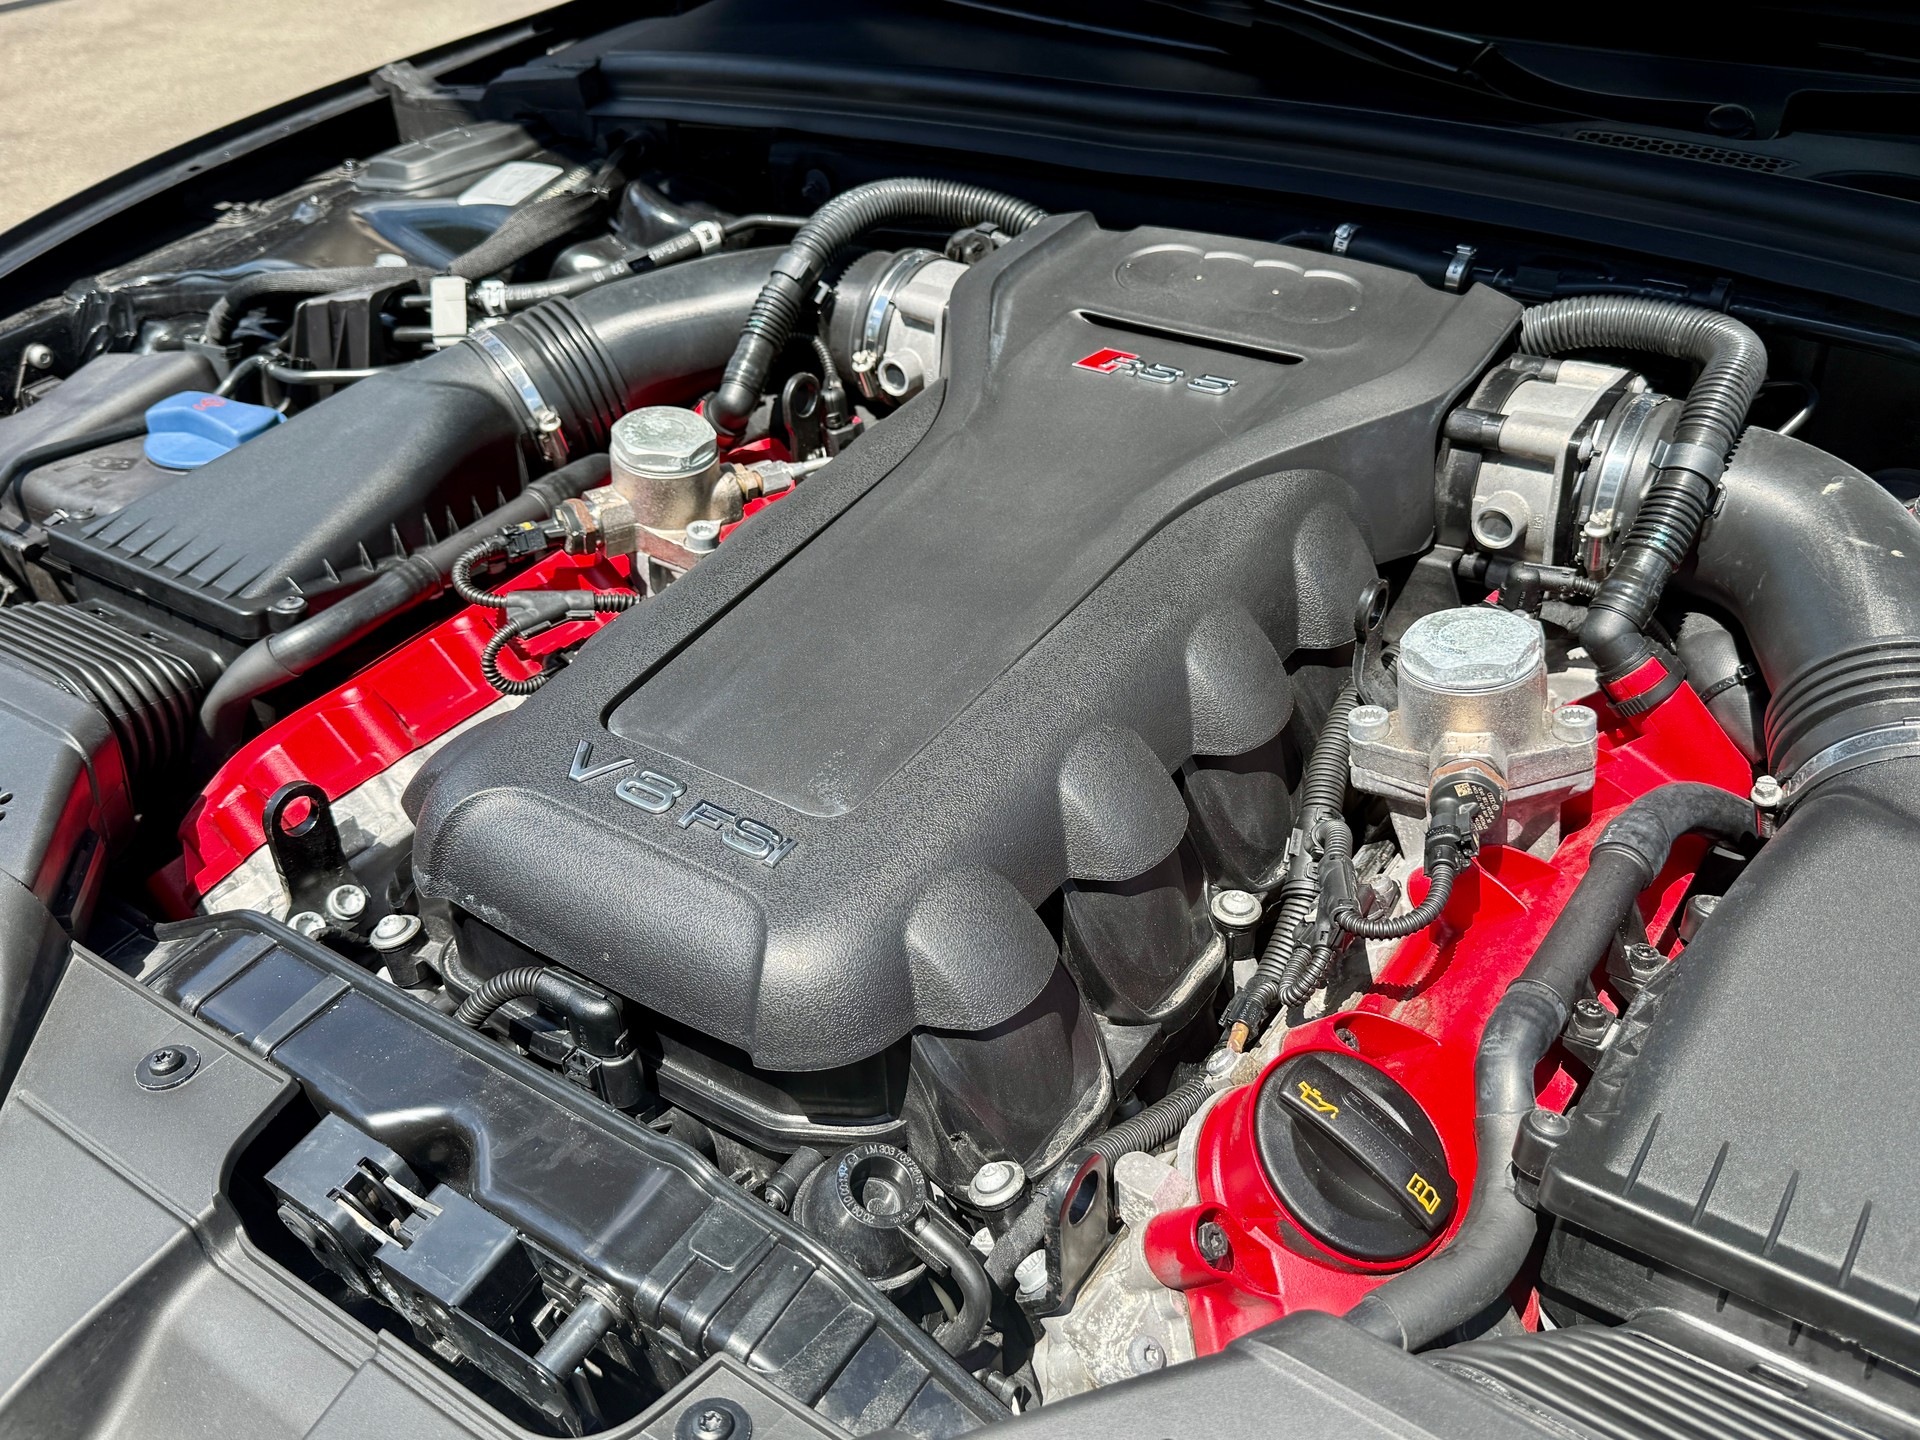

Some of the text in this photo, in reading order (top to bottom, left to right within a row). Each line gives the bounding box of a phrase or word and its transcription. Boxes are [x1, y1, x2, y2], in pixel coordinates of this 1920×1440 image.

[1071, 346, 1239, 396] RS 5
[568, 739, 799, 869] V8 FSI
